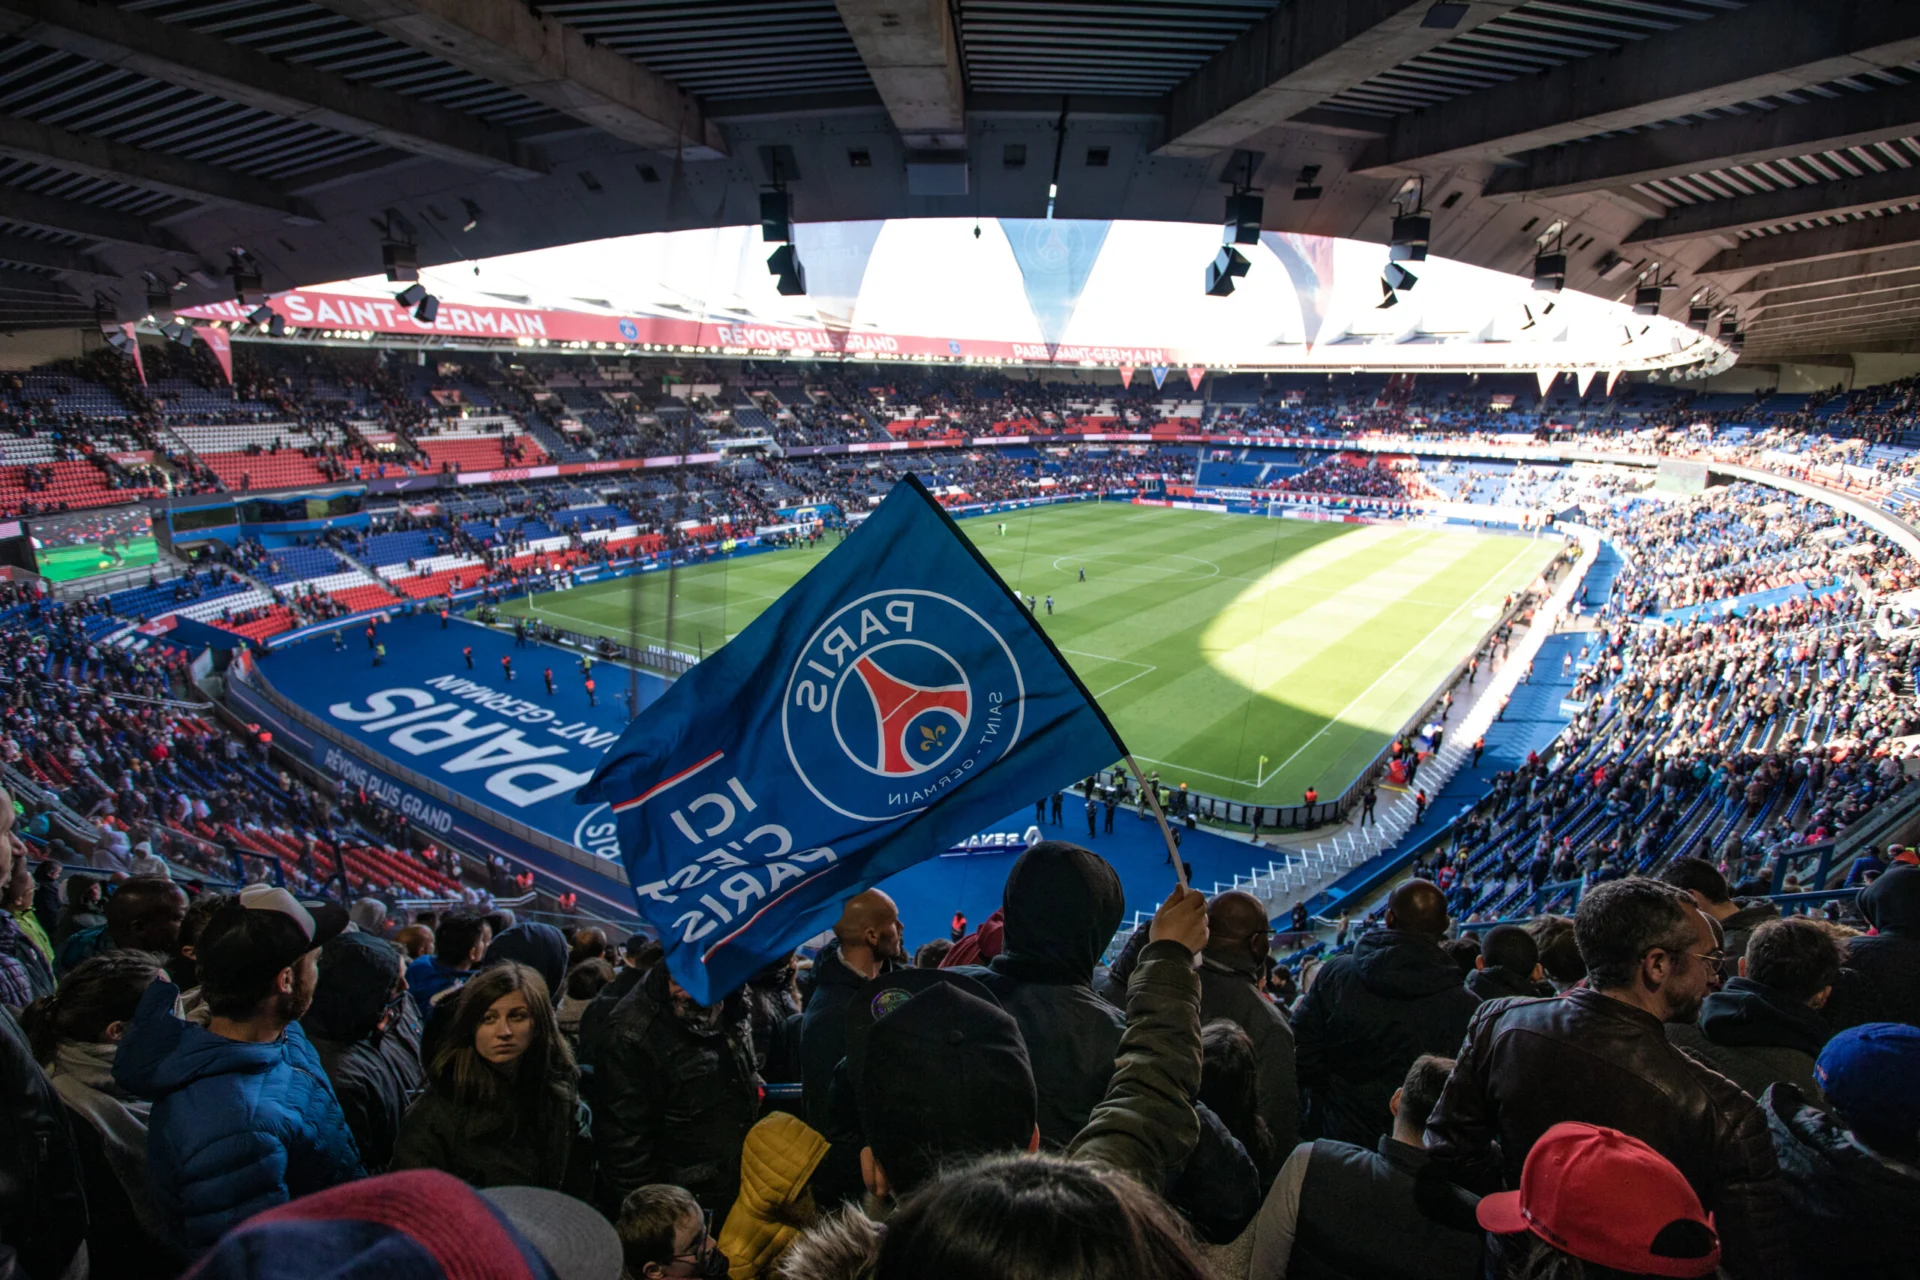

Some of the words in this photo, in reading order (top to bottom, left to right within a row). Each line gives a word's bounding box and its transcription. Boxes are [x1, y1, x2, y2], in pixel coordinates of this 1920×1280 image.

[796, 331, 841, 351] PLUS
[843, 333, 898, 352] GRAND
[1229, 436, 1344, 450] COLLECTIF
[1268, 492, 1331, 506] VIRAGE
[424, 674, 620, 754] INT-GERMAIN
[329, 688, 596, 807] PARIS
[324, 748, 368, 787] RÊVONS
[367, 774, 402, 806] PLUS
[401, 794, 452, 833] GRAND
[586, 823, 621, 859] RIS
